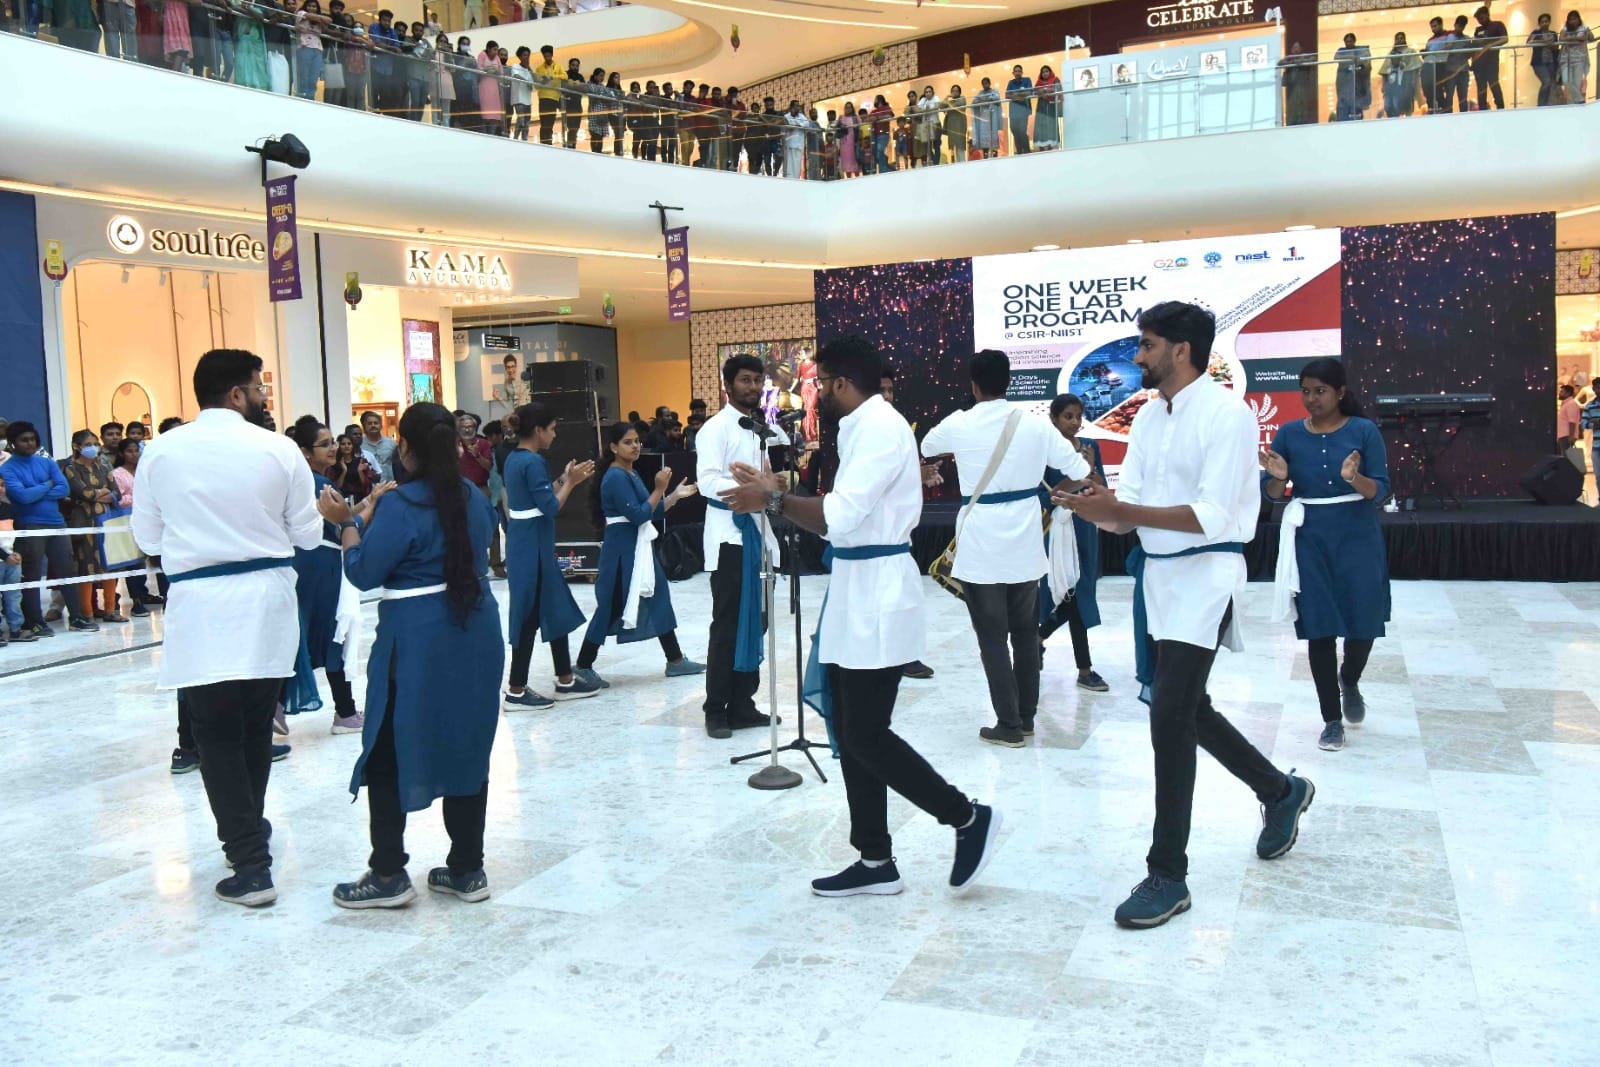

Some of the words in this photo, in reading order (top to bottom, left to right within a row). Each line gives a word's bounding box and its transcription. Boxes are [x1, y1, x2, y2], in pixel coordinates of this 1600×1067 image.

[1147, 1, 1254, 27] CELEBRATE
[151, 228, 265, 261] soultree
[409, 249, 508, 275] KAMA
[409, 271, 511, 288] AYURVEDA
[1003, 282, 1061, 299] ONE
[1069, 276, 1147, 295] WEEK
[1003, 297, 1061, 314] ONE
[1070, 293, 1123, 310] LAB
[1004, 307, 1142, 329] PROGRAM
[1017, 328, 1083, 339] CSIR-NIIST
